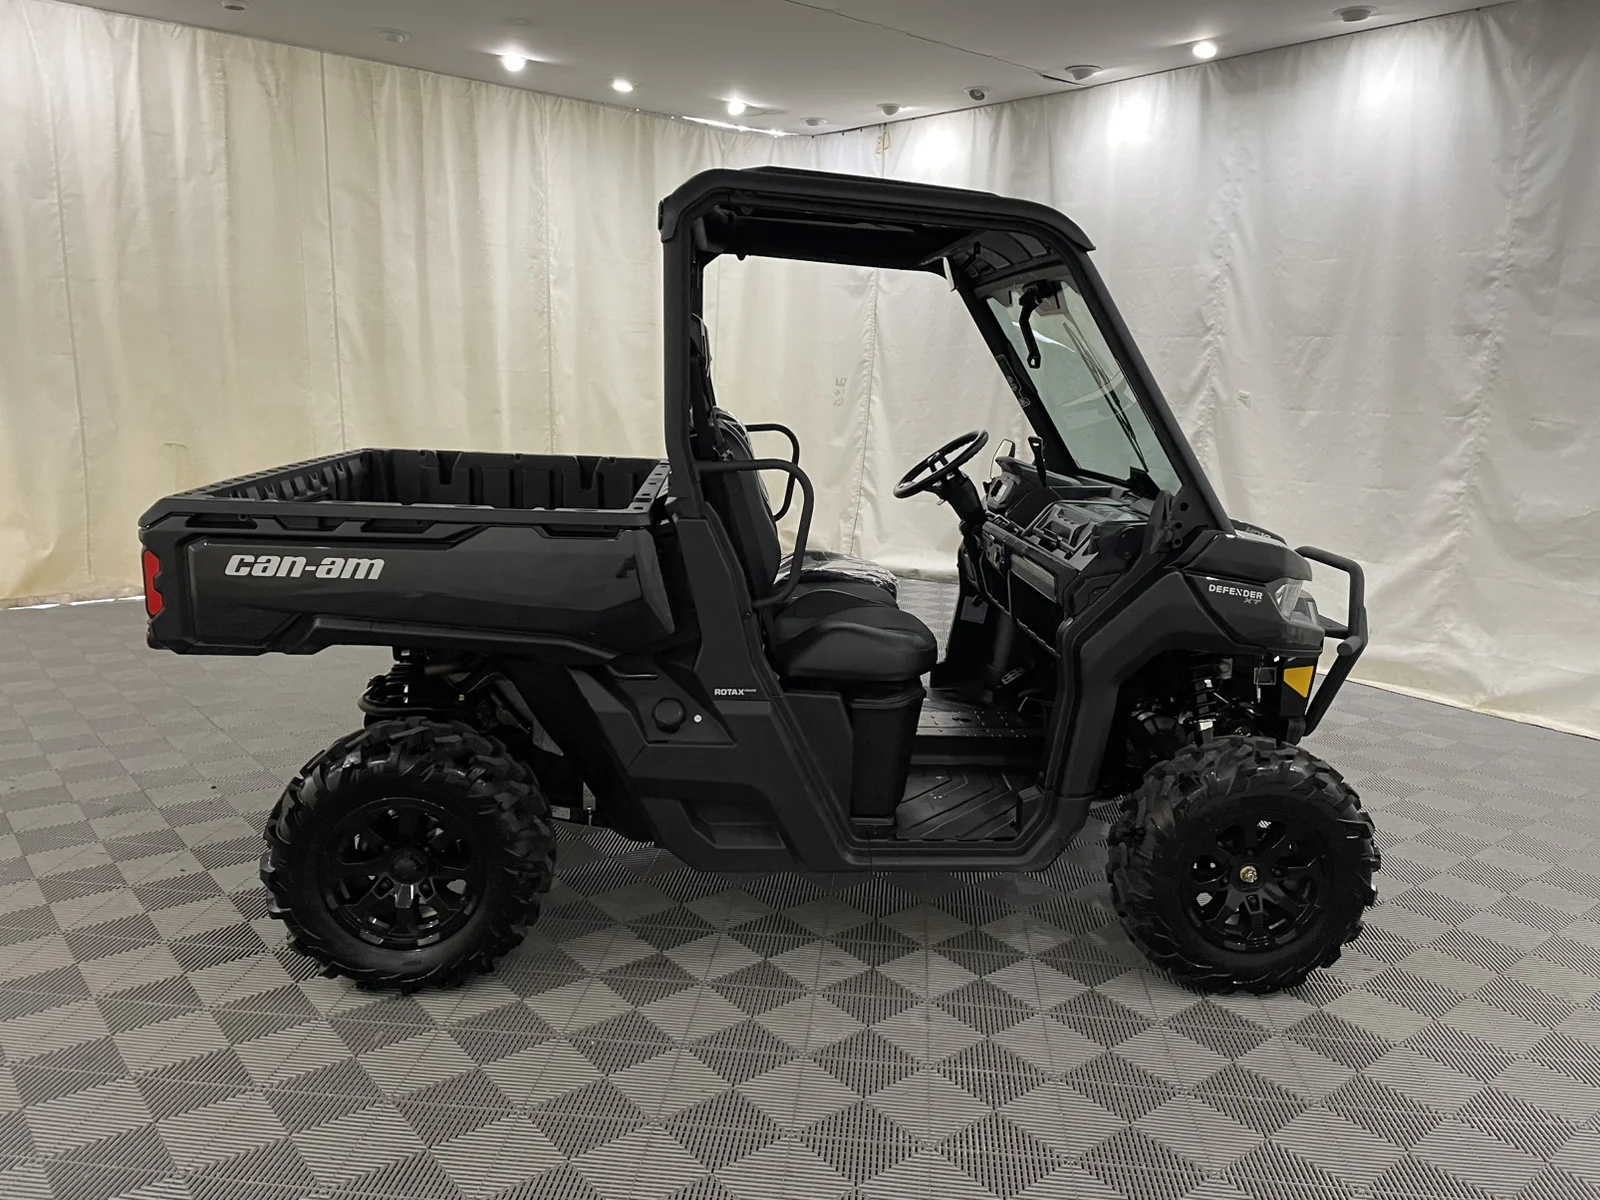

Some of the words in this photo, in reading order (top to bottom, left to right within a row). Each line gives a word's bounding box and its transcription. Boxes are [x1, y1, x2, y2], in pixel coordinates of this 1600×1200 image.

[224, 554, 385, 580] can-am
[1208, 584, 1263, 600] DEFENDER
[714, 688, 745, 696] ROTAX
